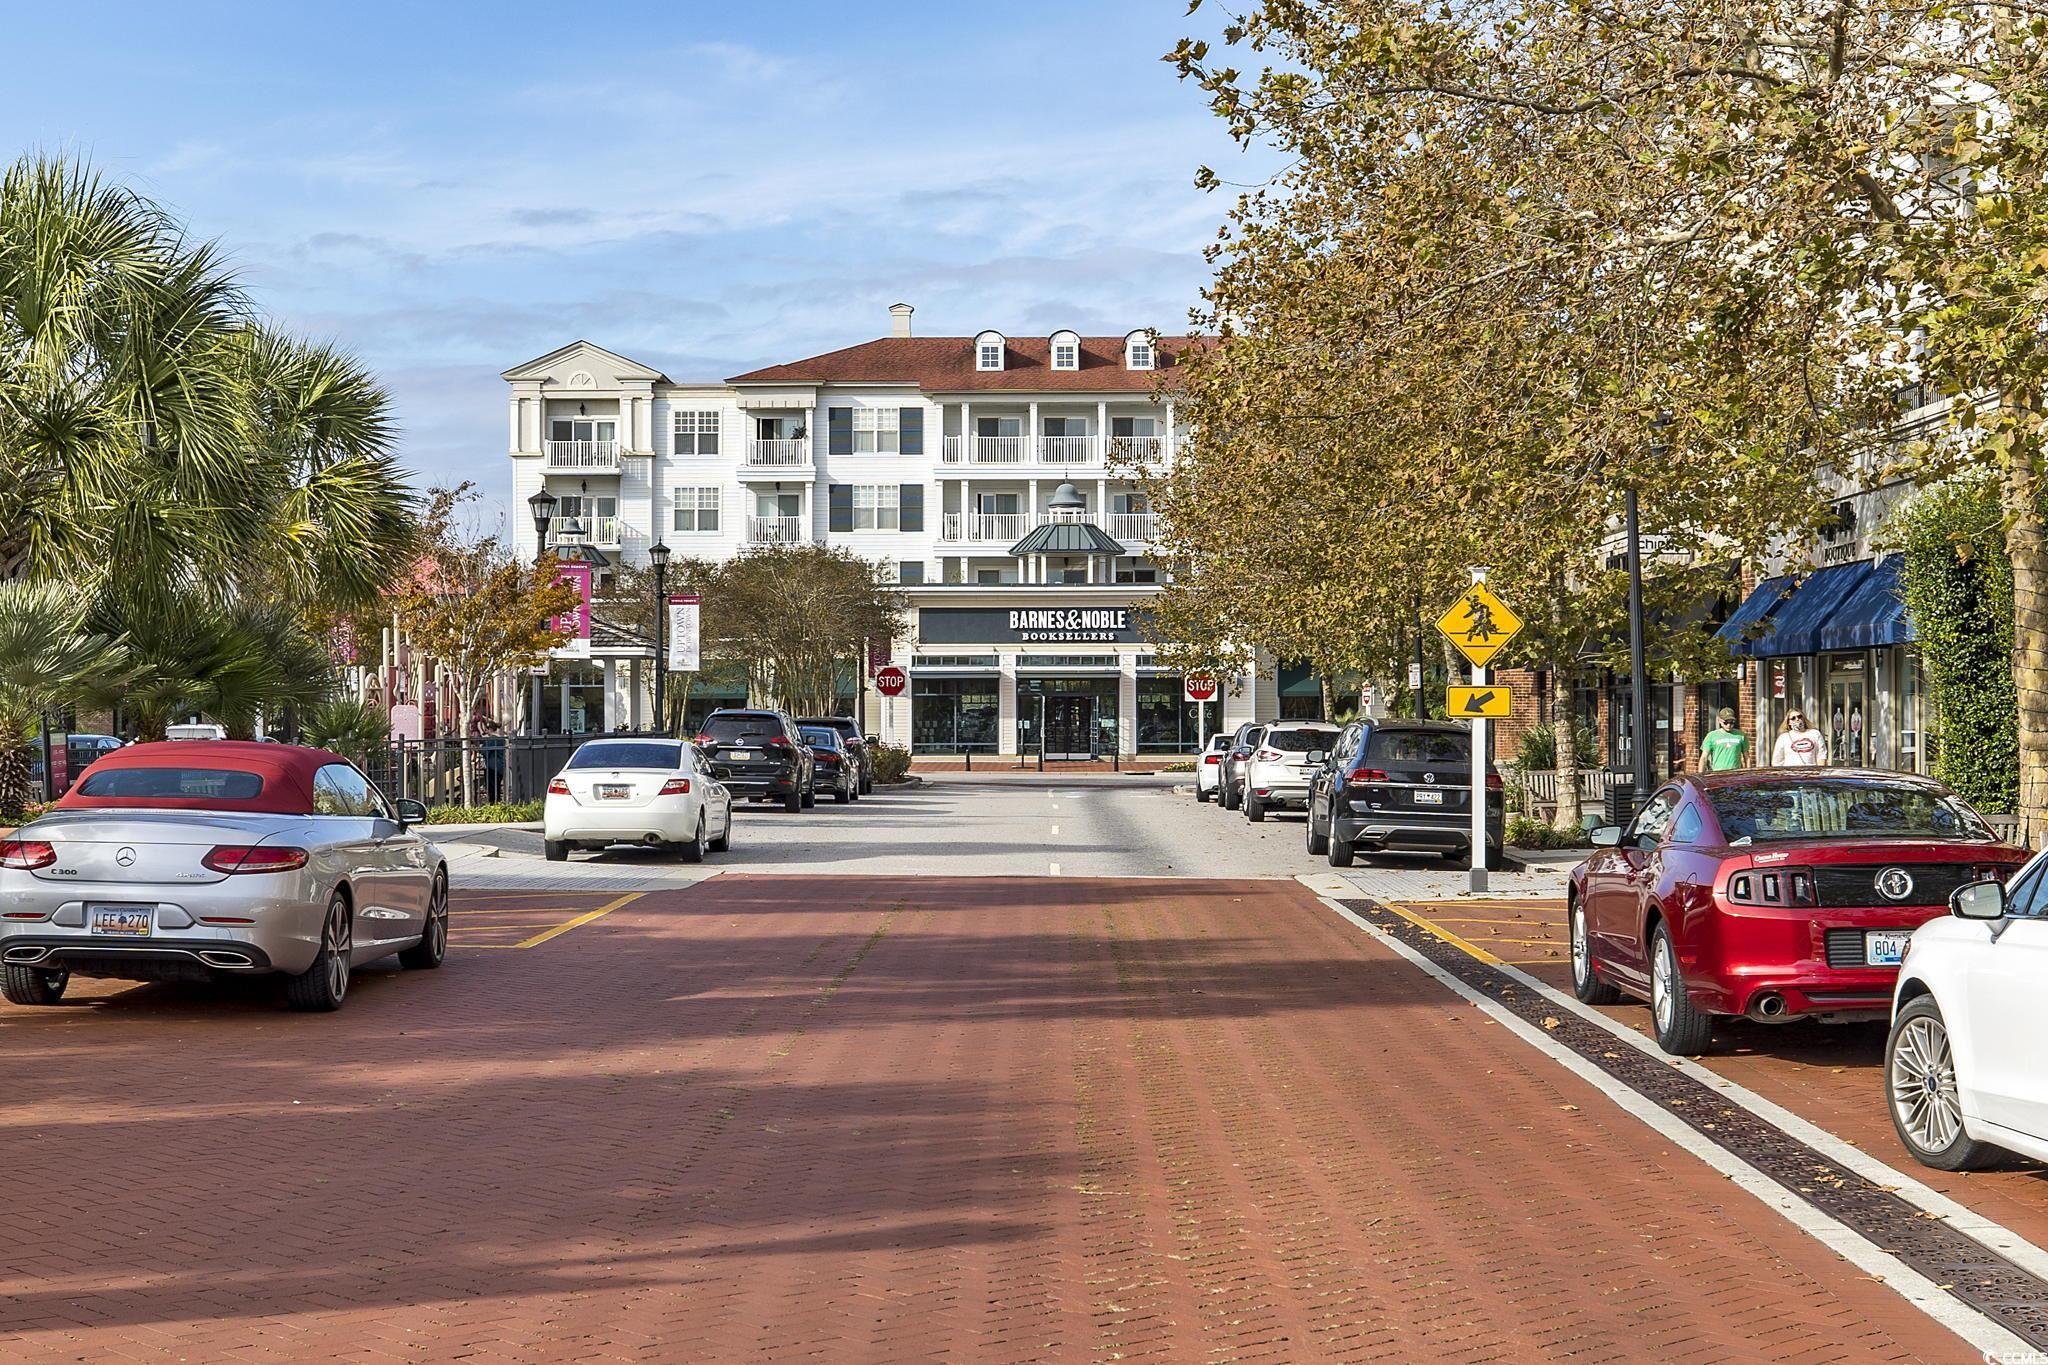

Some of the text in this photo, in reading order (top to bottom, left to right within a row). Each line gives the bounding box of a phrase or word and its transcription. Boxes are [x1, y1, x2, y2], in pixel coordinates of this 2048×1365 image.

[1825, 542, 1856, 562] BOUTIQUE
[676, 607, 686, 653] UPTOWN
[1022, 631, 1115, 641] BOOKSELLERS
[878, 675, 904, 687] STOP
[95, 913, 149, 929] LEE 270
[1875, 941, 1897, 956] 804
